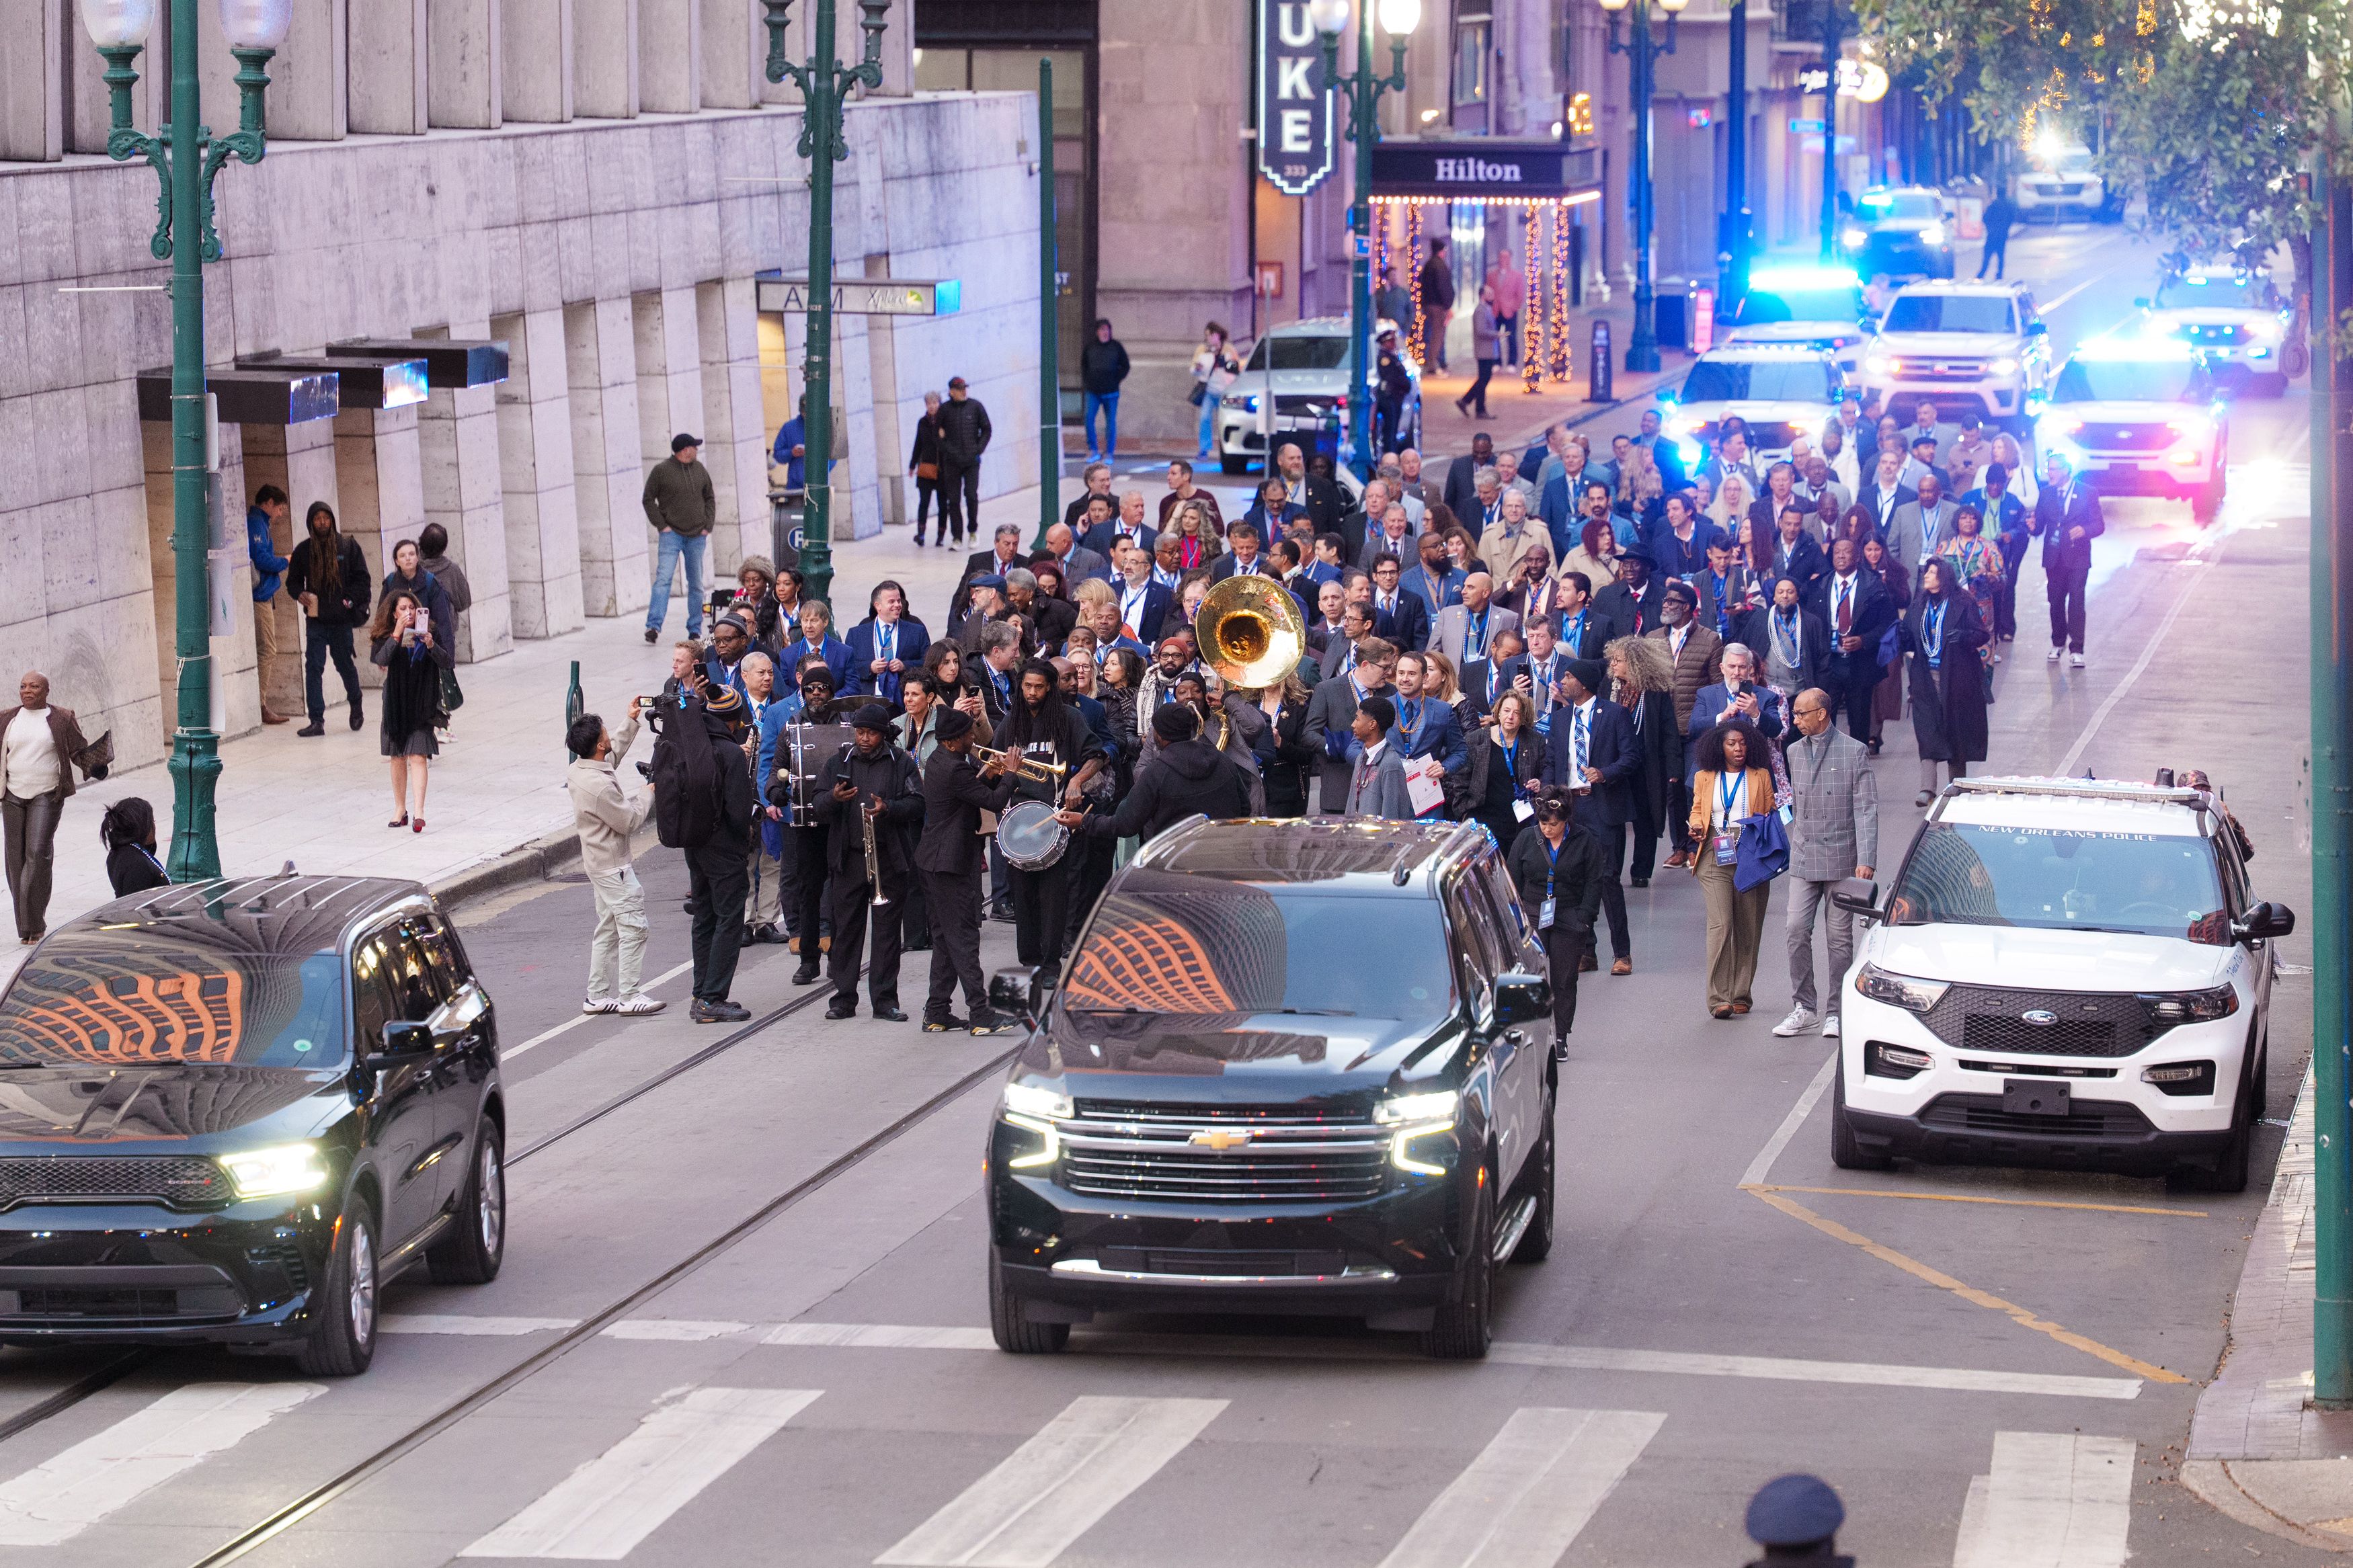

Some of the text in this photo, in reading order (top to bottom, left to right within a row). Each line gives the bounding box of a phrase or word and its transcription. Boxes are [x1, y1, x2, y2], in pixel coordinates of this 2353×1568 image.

[1435, 157, 1523, 182] Hilton
[1979, 825, 2157, 842] NEW ORLEANS POLICE
